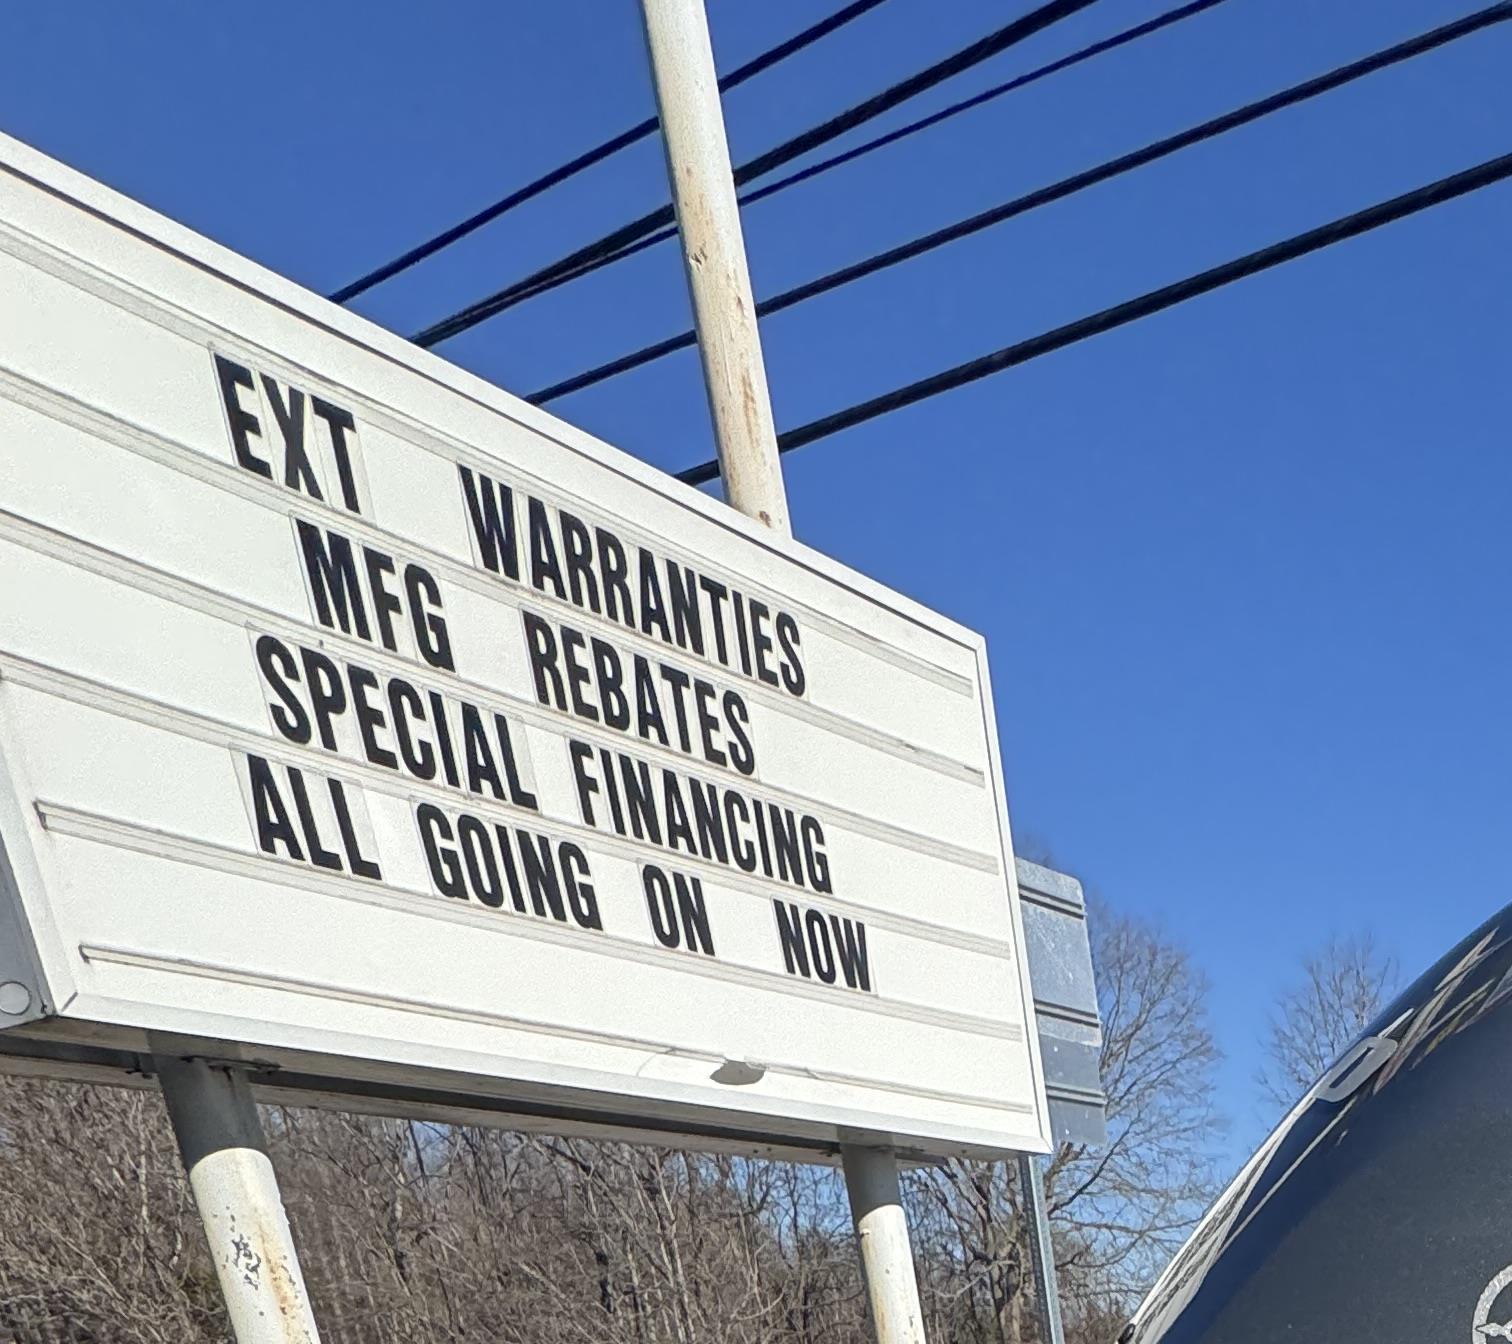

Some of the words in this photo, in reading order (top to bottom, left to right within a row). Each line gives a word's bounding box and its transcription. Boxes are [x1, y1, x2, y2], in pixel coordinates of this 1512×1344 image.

[214, 354, 361, 514] EXT
[458, 464, 806, 697] WARRANTIES
[295, 518, 456, 672] MFG
[522, 610, 755, 776] REBATES
[247, 753, 382, 881] ALL
[416, 802, 603, 931] GOING
[642, 864, 715, 956] ON
[773, 899, 871, 992] NOW
[256, 635, 539, 811] SPECIAL
[569, 739, 833, 894] FINANCING
